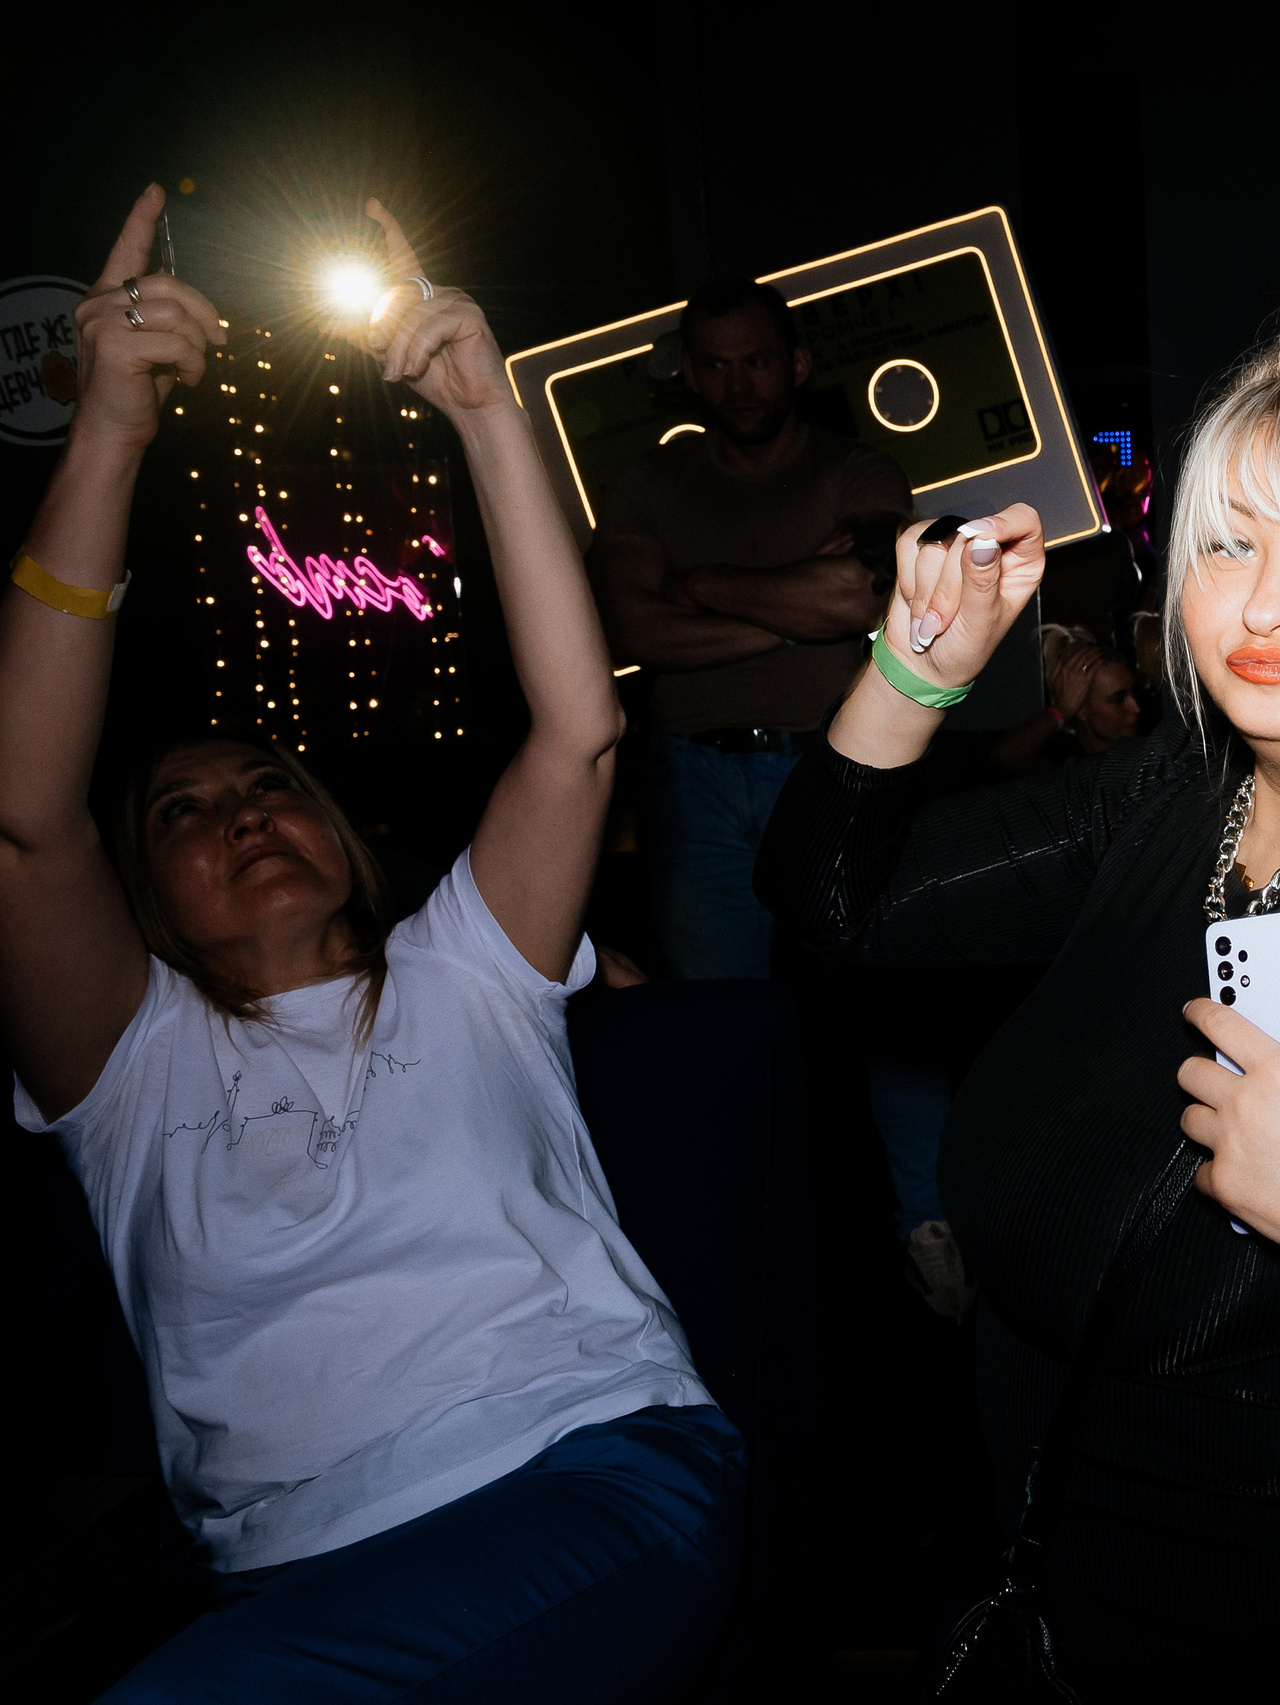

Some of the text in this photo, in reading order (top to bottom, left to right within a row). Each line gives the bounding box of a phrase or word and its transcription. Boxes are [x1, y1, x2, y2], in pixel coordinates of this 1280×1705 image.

[0, 313, 74, 364] ГДЕ ЖЕ
[838, 344, 888, 367] ЗАБУДУ
[892, 331, 926, 350] ТЕБЯ
[928, 311, 993, 340] НИКОГДА
